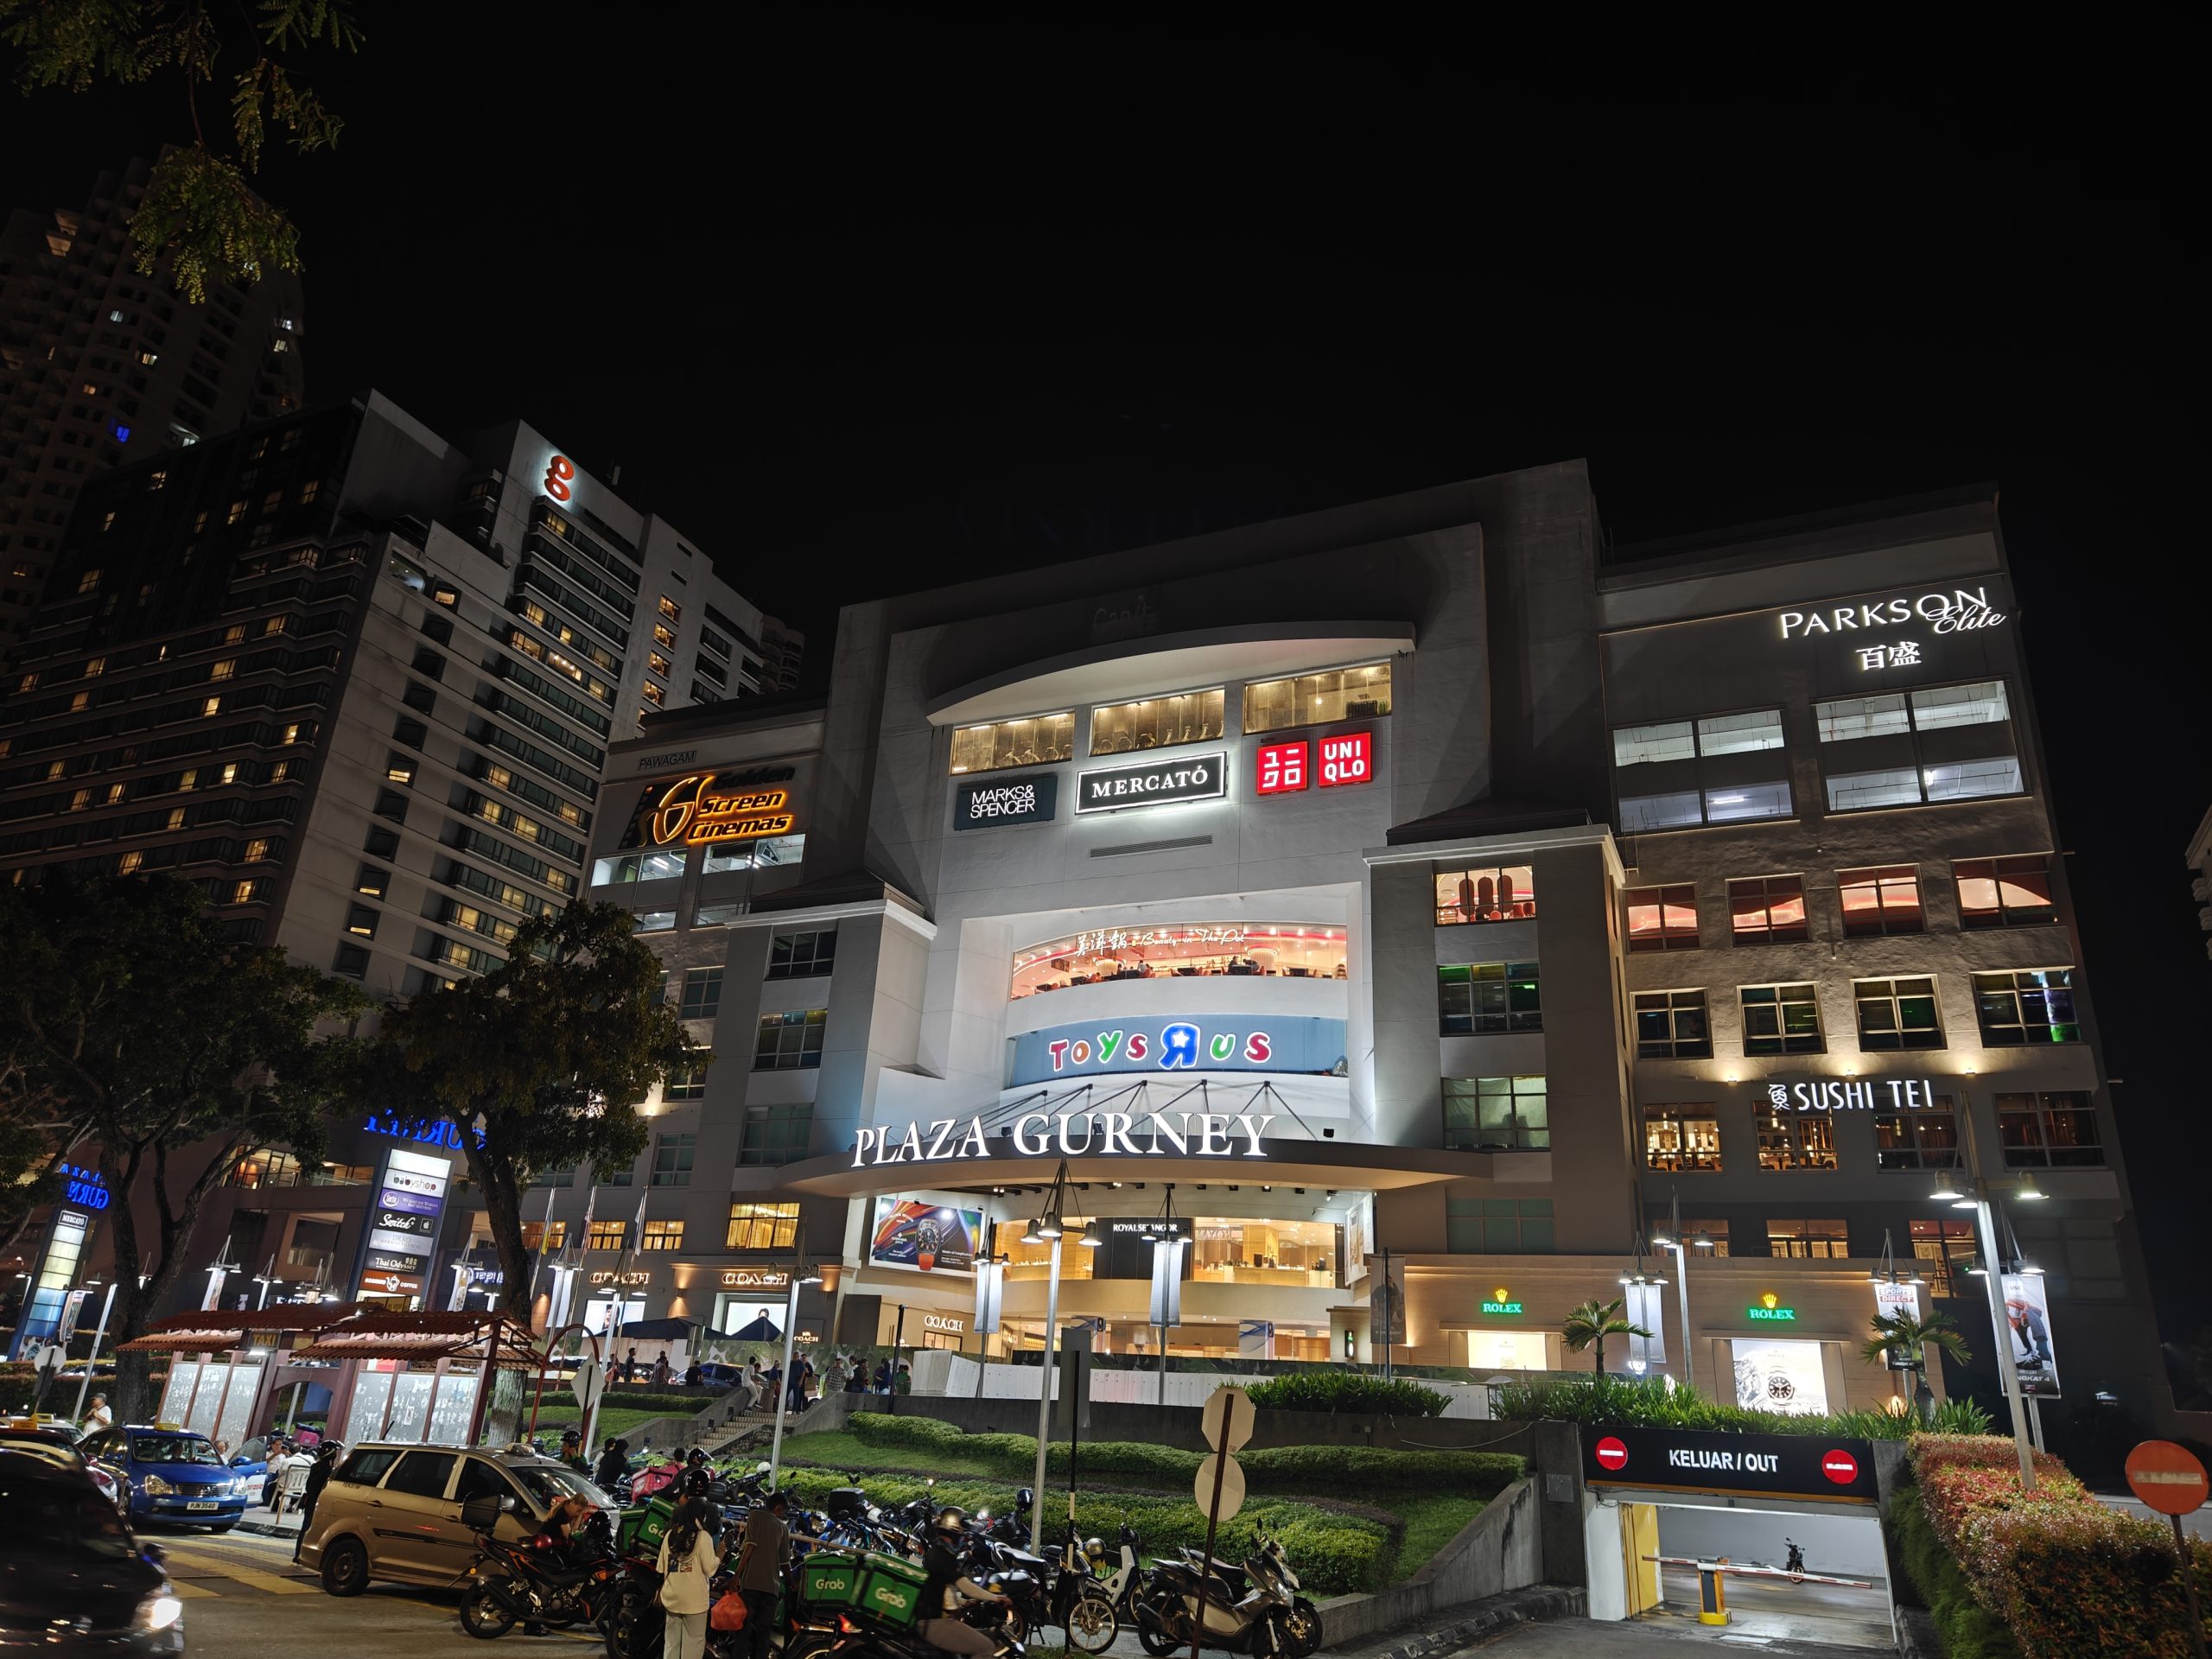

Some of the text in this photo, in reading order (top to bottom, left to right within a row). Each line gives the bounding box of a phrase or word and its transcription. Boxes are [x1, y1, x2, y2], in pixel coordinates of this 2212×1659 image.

[1780, 587, 1988, 639] PARKSON
[1925, 604, 2006, 634] Elite
[1856, 641, 1922, 671] 百盛
[1325, 741, 1361, 760] UNI
[639, 752, 696, 770] PAWAGAM
[1325, 760, 1365, 782] QLO
[1091, 765, 1208, 798] MERCATÓ
[698, 791, 786, 816] Screen
[970, 798, 1035, 818] SPENCER
[687, 815, 791, 842] Cinemas
[1140, 932, 1178, 946] Beauty
[1219, 929, 1245, 945] Pot
[1794, 1082, 1874, 1111] SUSHI
[1886, 1079, 1933, 1108] TEI
[851, 1112, 1278, 1167] PLAZA GURNEY
[393, 1174, 436, 1192] babyshop
[378, 1213, 416, 1230] Switch
[375, 1257, 390, 1267] Thai
[390, 1260, 416, 1270] Odyssey
[1483, 1303, 1522, 1313] ROLEX
[1749, 1308, 1796, 1319] ROLEX
[925, 1315, 963, 1332] COACH
[253, 1333, 276, 1346] TAXI
[1669, 1449, 1734, 1470] KELUAR
[1745, 1453, 1779, 1472] OUT
[816, 1578, 845, 1590] Grab
[874, 1587, 906, 1608] Grab
